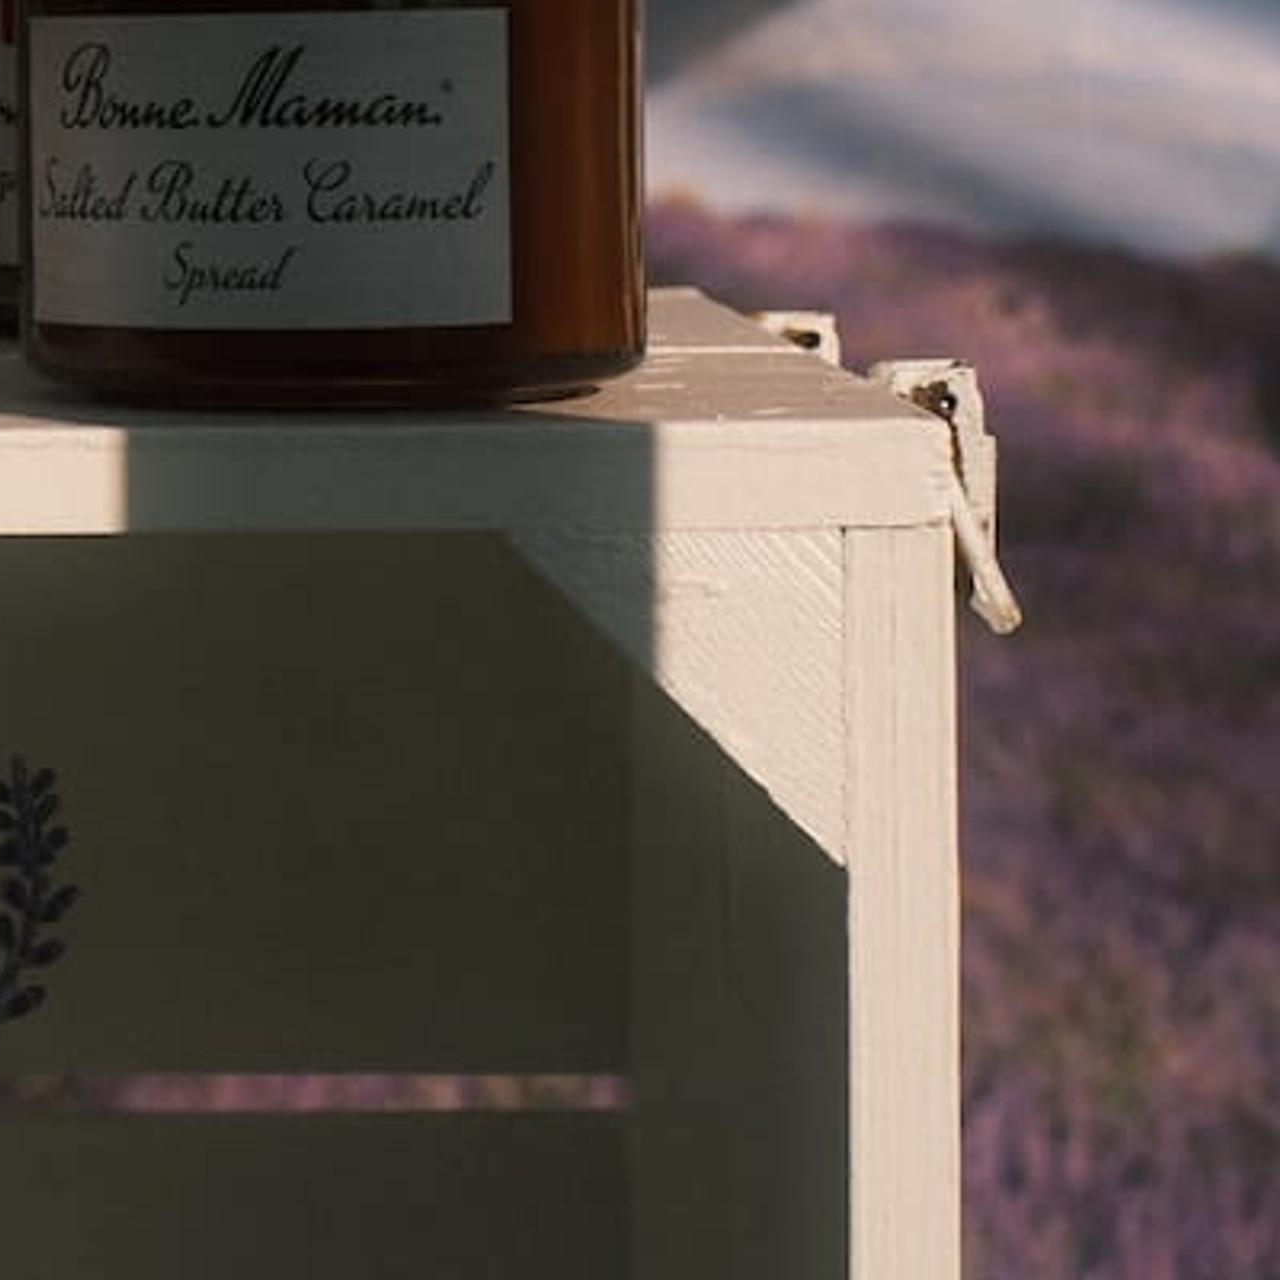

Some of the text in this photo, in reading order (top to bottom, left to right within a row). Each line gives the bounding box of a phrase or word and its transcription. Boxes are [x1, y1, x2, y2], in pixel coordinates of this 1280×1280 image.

[61, 42, 198, 130] Bonne
[39, 156, 495, 225] Salted Butter Caramel
[163, 241, 299, 307] Spread
